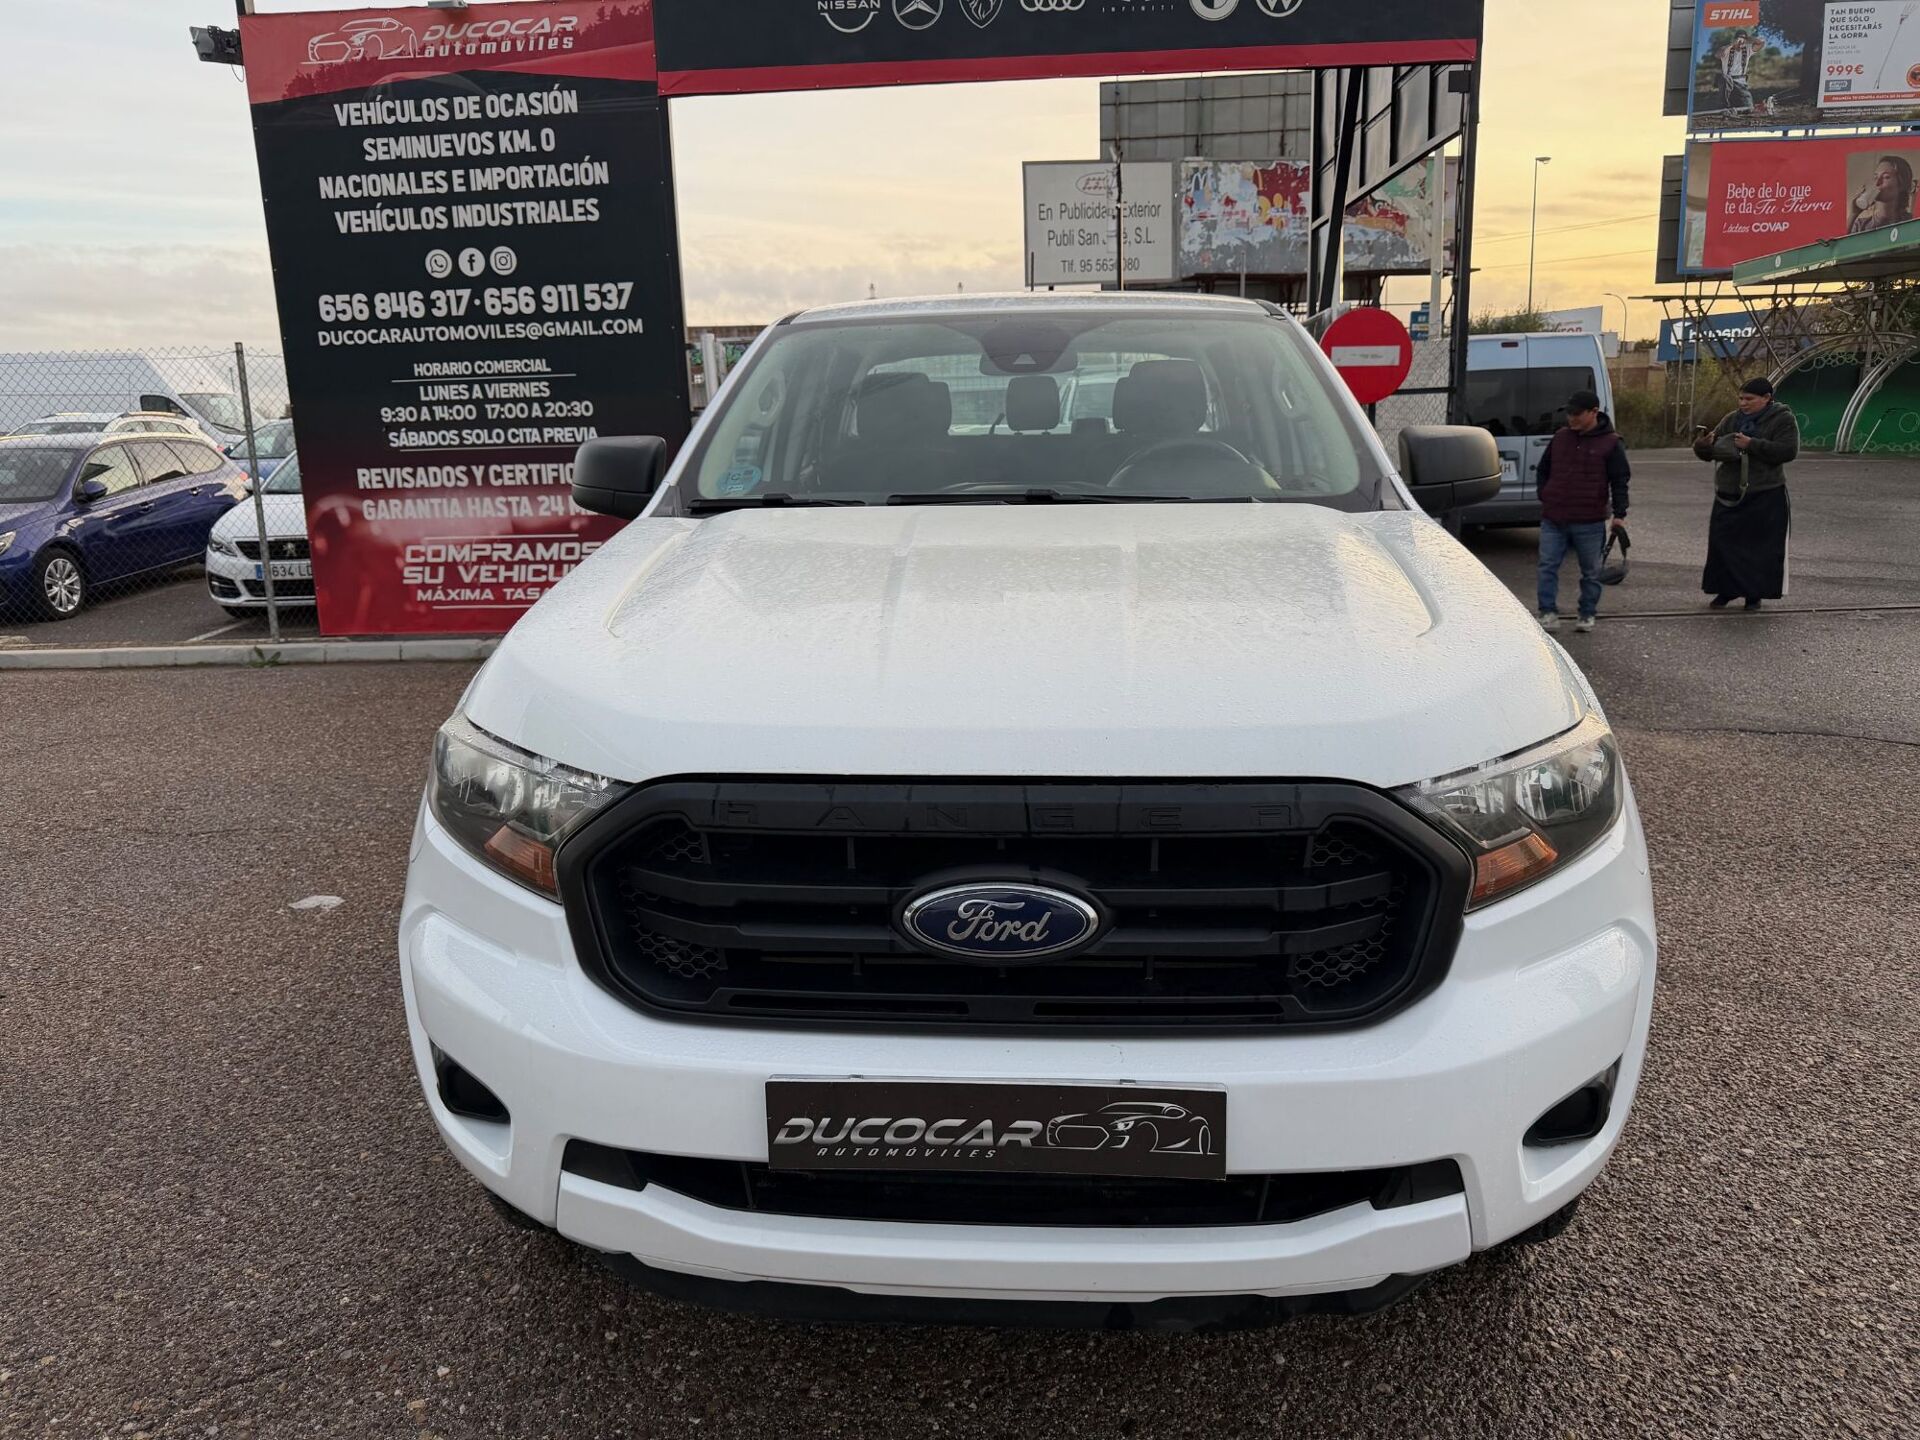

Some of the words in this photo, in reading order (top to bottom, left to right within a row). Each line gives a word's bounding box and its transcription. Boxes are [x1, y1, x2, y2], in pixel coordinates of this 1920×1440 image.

[817, 0, 880, 10] NISSAN
[1709, 8, 1753, 20] STIHL
[422, 16, 578, 41] DUCOCAR
[1829, 22, 1883, 32] NECESITARÁS
[1827, 64, 1864, 76] 999€
[333, 94, 450, 127] VEHÍCULOS
[453, 95, 482, 120] DE
[485, 83, 579, 118] OCASIÓN
[362, 131, 495, 161] SEMINUEVOS
[498, 129, 538, 154] KM.
[318, 170, 449, 200] NACIONALES
[451, 169, 467, 193] E
[469, 155, 610, 191] IMPORTACIÓN
[1727, 183, 1755, 199] Bebe
[1758, 182, 1773, 198] de
[1775, 181, 1787, 197] lo
[1790, 185, 1812, 201] que
[334, 202, 449, 234] VEHÍCULOS
[452, 198, 601, 229] INDUSTRIALES
[1038, 203, 1053, 221] En
[1060, 202, 1112, 221] Publicida
[1122, 200, 1162, 219] Exterior
[1724, 201, 1736, 214] te
[1738, 199, 1753, 214] da
[1753, 198, 1777, 215] Tu
[1781, 197, 1834, 213] Tierra
[1047, 229, 1075, 247] Publi
[1078, 228, 1100, 246] San
[1134, 226, 1156, 245] S.L.
[1751, 221, 1790, 233] COVAP
[1079, 258, 1093, 273] 95
[1095, 256, 1141, 273] 563080
[318, 293, 370, 323] 656
[373, 291, 426, 320] 846
[540, 283, 580, 314] 911
[583, 281, 634, 312] 537
[317, 318, 644, 347] DUCOCARAUTOMOVILES@GMAIL.COM
[413, 361, 472, 377] HORARIO
[474, 358, 551, 375] COMERCIAL
[419, 384, 470, 401] LUNES
[472, 384, 484, 399] A
[485, 381, 551, 398] VIERNES
[380, 407, 418, 423] 9:30
[420, 406, 432, 421] A
[434, 404, 477, 422] 14:00
[485, 402, 529, 419] 17:00
[531, 402, 543, 417] A
[545, 400, 594, 417] 20:30
[388, 428, 460, 448] SÁBADOS
[461, 429, 504, 445] SOLO
[507, 428, 543, 444] CITA
[543, 426, 598, 443] PREVIA
[356, 465, 470, 490] REVISADOS
[471, 464, 485, 487] Y
[488, 462, 574, 487] CERTIFIC
[467, 495, 534, 518] HASTA
[536, 495, 566, 517] 24
[405, 541, 602, 563] COMPRAMOS
[402, 565, 445, 584] SU
[416, 586, 495, 601] MÁXIMA
[502, 587, 549, 601] TAS
[946, 898, 1050, 943] Ford
[773, 1117, 1044, 1148] DUCOCAR
[816, 1147, 997, 1159] AUTOMÓVILES
